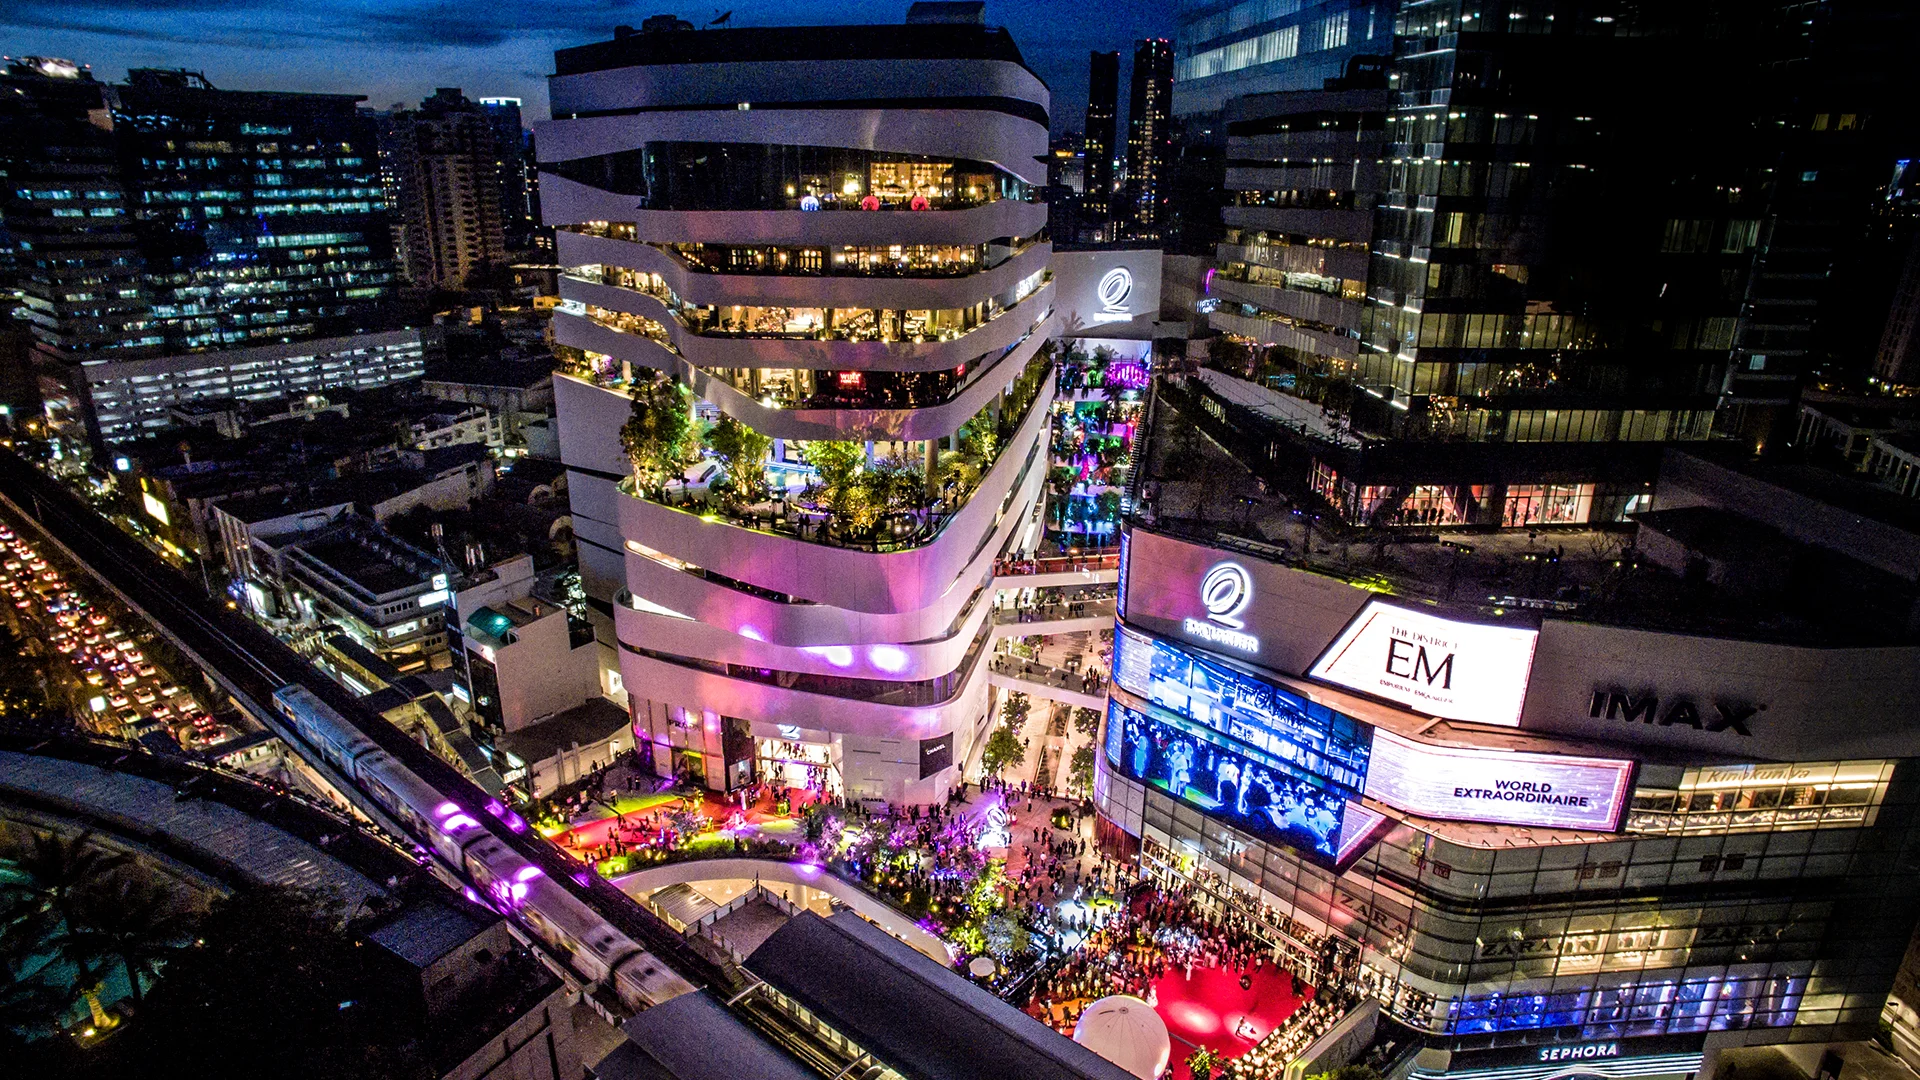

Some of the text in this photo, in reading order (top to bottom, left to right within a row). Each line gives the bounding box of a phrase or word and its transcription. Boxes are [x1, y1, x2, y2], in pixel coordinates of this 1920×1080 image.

[1412, 631, 1458, 649] DISTRIT
[1386, 637, 1455, 690] EM
[1588, 691, 1758, 737] IMAX
[1495, 779, 1552, 793] WORLD
[1453, 787, 1589, 807] EXTRAORDINAIRE
[1340, 893, 1405, 936] ZARA
[1481, 940, 1553, 956] ZARA
[1540, 1043, 1618, 1061] SEPHORA
